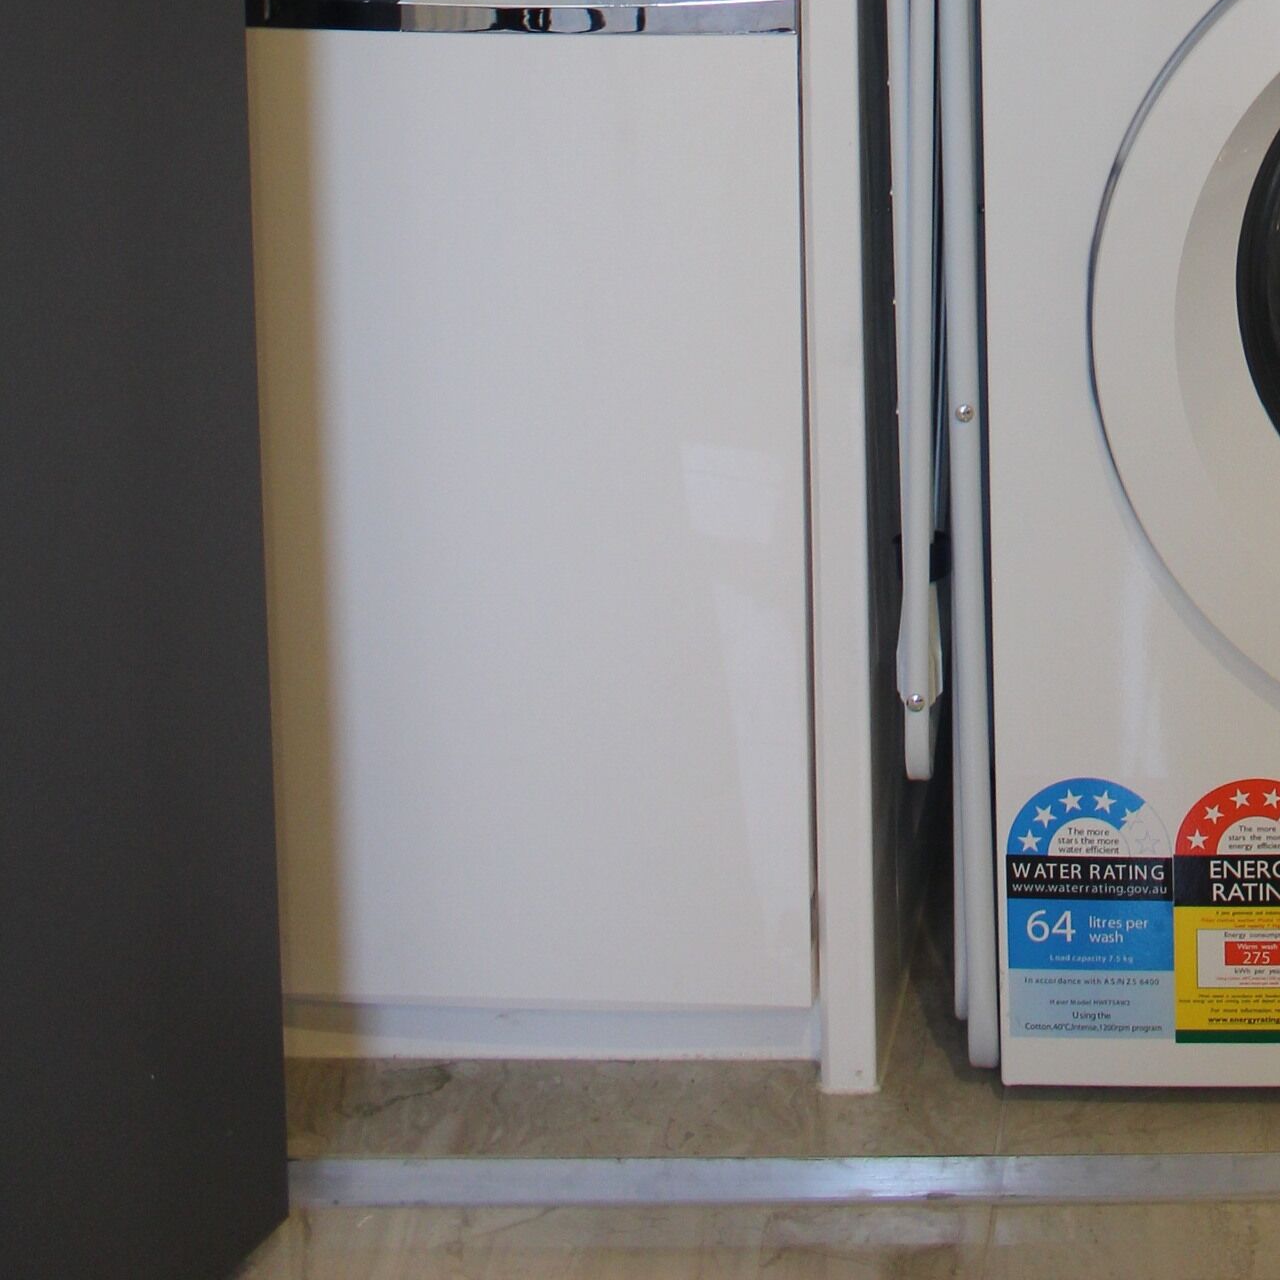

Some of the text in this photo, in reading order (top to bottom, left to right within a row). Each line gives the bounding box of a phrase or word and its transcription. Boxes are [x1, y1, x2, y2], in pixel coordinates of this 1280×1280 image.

[1068, 827, 1110, 837] The more
[1239, 825, 1254, 833] The
[1058, 836, 1119, 845] stars the more
[1228, 834, 1247, 842] stars
[1250, 834, 1263, 842] the
[1058, 844, 1119, 855] water efficient
[1228, 843, 1254, 851] energy
[1012, 864, 1165, 881] WATER RATING
[1012, 883, 1167, 895] www.waterrating.gov.au
[1026, 910, 1076, 943] 64
[1089, 915, 1149, 932] litres per
[1089, 930, 1124, 944] wash
[1224, 931, 1247, 940] Energy
[1049, 954, 1070, 963] Load
[1072, 955, 1107, 965] capacity
[1122, 955, 1134, 965] kg
[1243, 951, 1270, 965] 275
[1024, 977, 1033, 985] In
[1035, 977, 1080, 985] accordance
[1083, 977, 1101, 985] with
[1072, 1011, 1111, 1021] Using the
[1131, 1024, 1163, 1033] program
